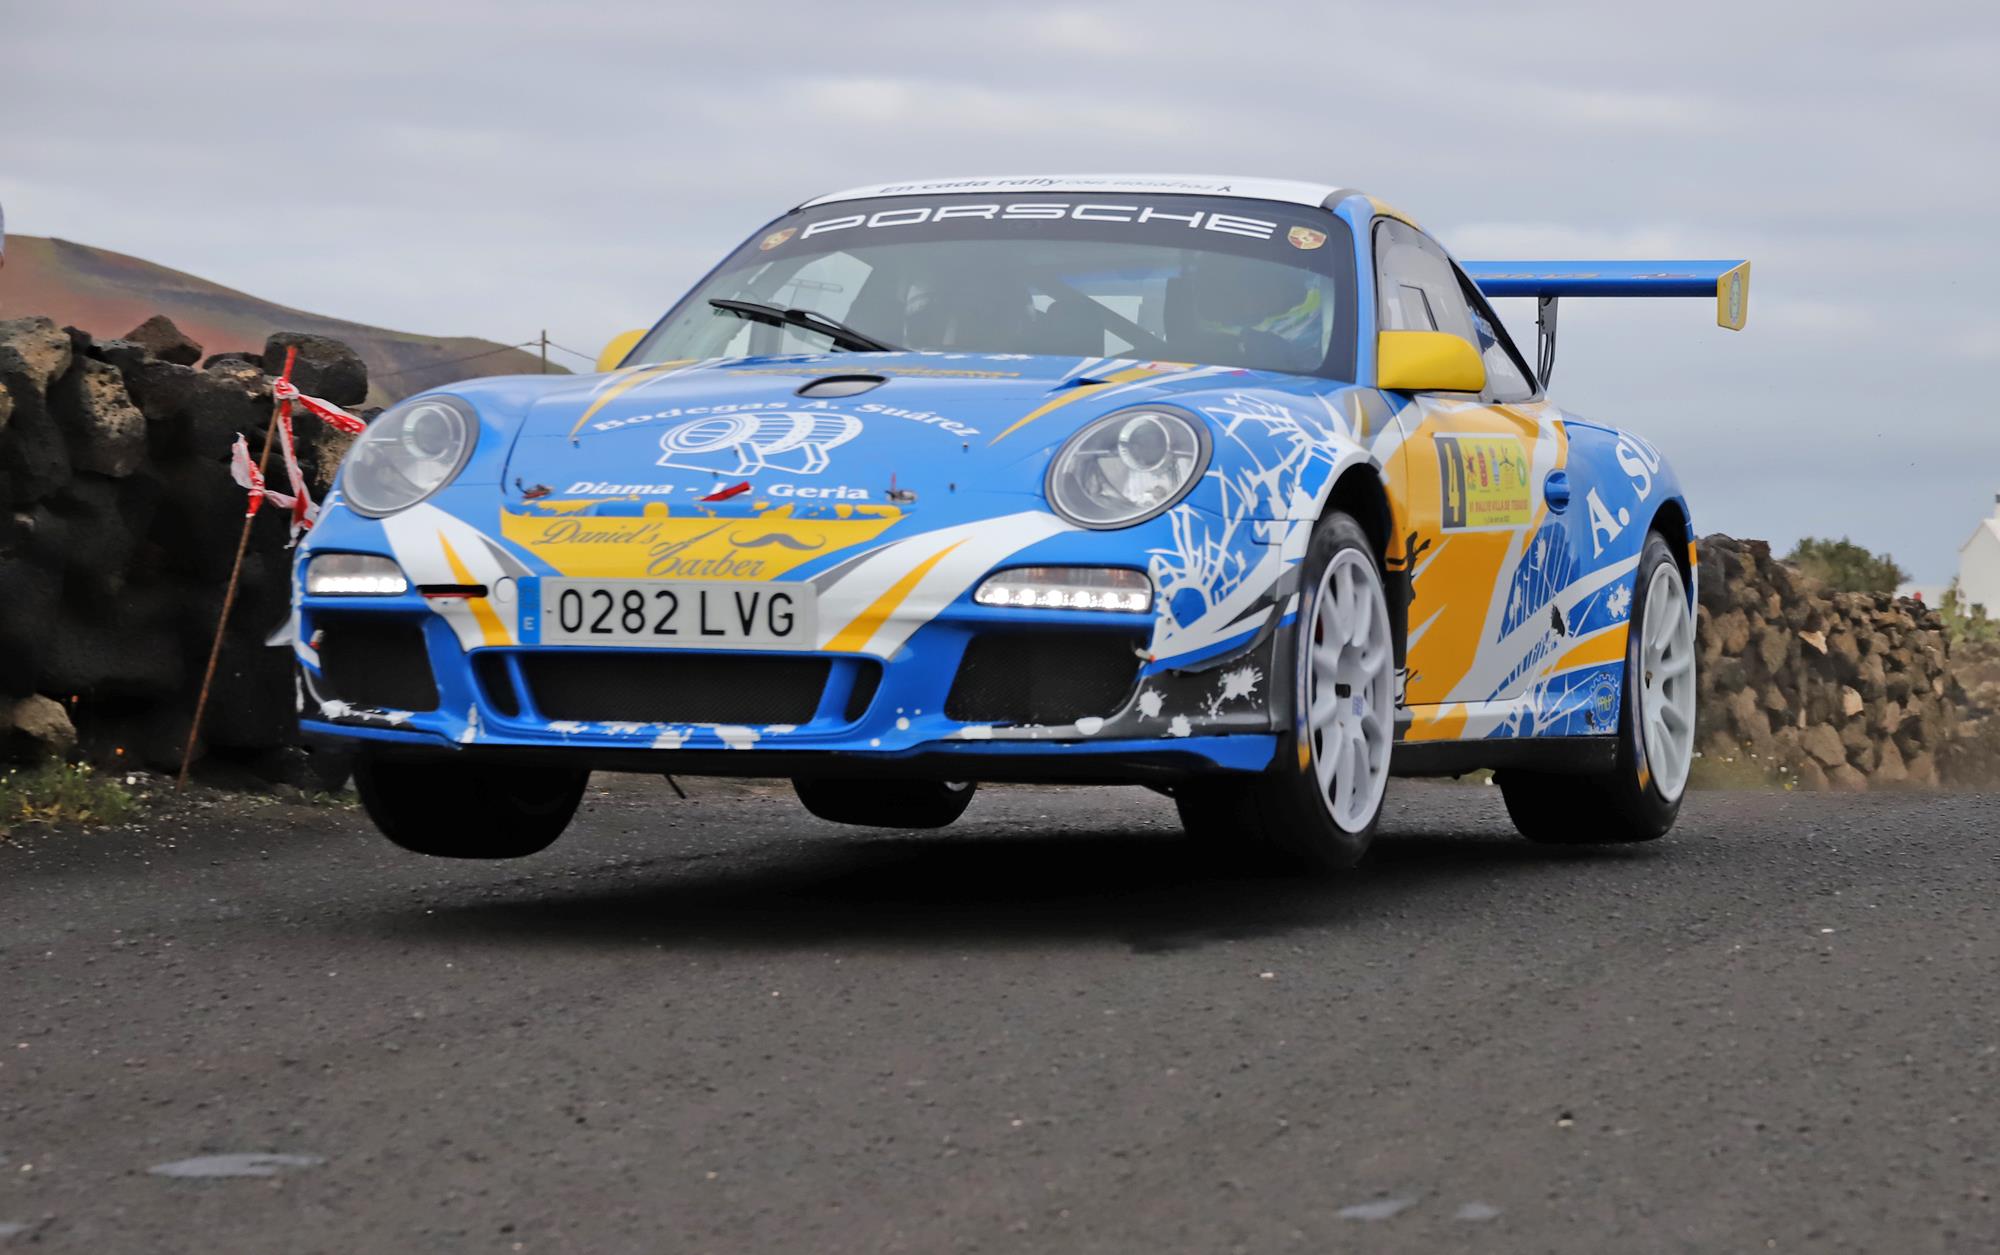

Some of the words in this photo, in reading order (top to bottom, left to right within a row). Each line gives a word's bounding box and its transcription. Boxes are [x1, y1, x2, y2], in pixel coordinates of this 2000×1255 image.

[922, 180, 991, 190] cada
[996, 177, 1063, 187] rally
[800, 203, 1277, 240] PORSCHE
[592, 401, 789, 431] Bodegas
[797, 401, 840, 410] A.
[855, 403, 982, 437] Suárez
[564, 481, 675, 495] Diama
[767, 483, 870, 500] Geria
[530, 518, 664, 546] Daniel's
[1586, 487, 1630, 560] A.
[646, 520, 765, 577] Barber
[523, 616, 535, 631] E
[559, 588, 679, 635] 0282
[700, 590, 795, 637] LVG
